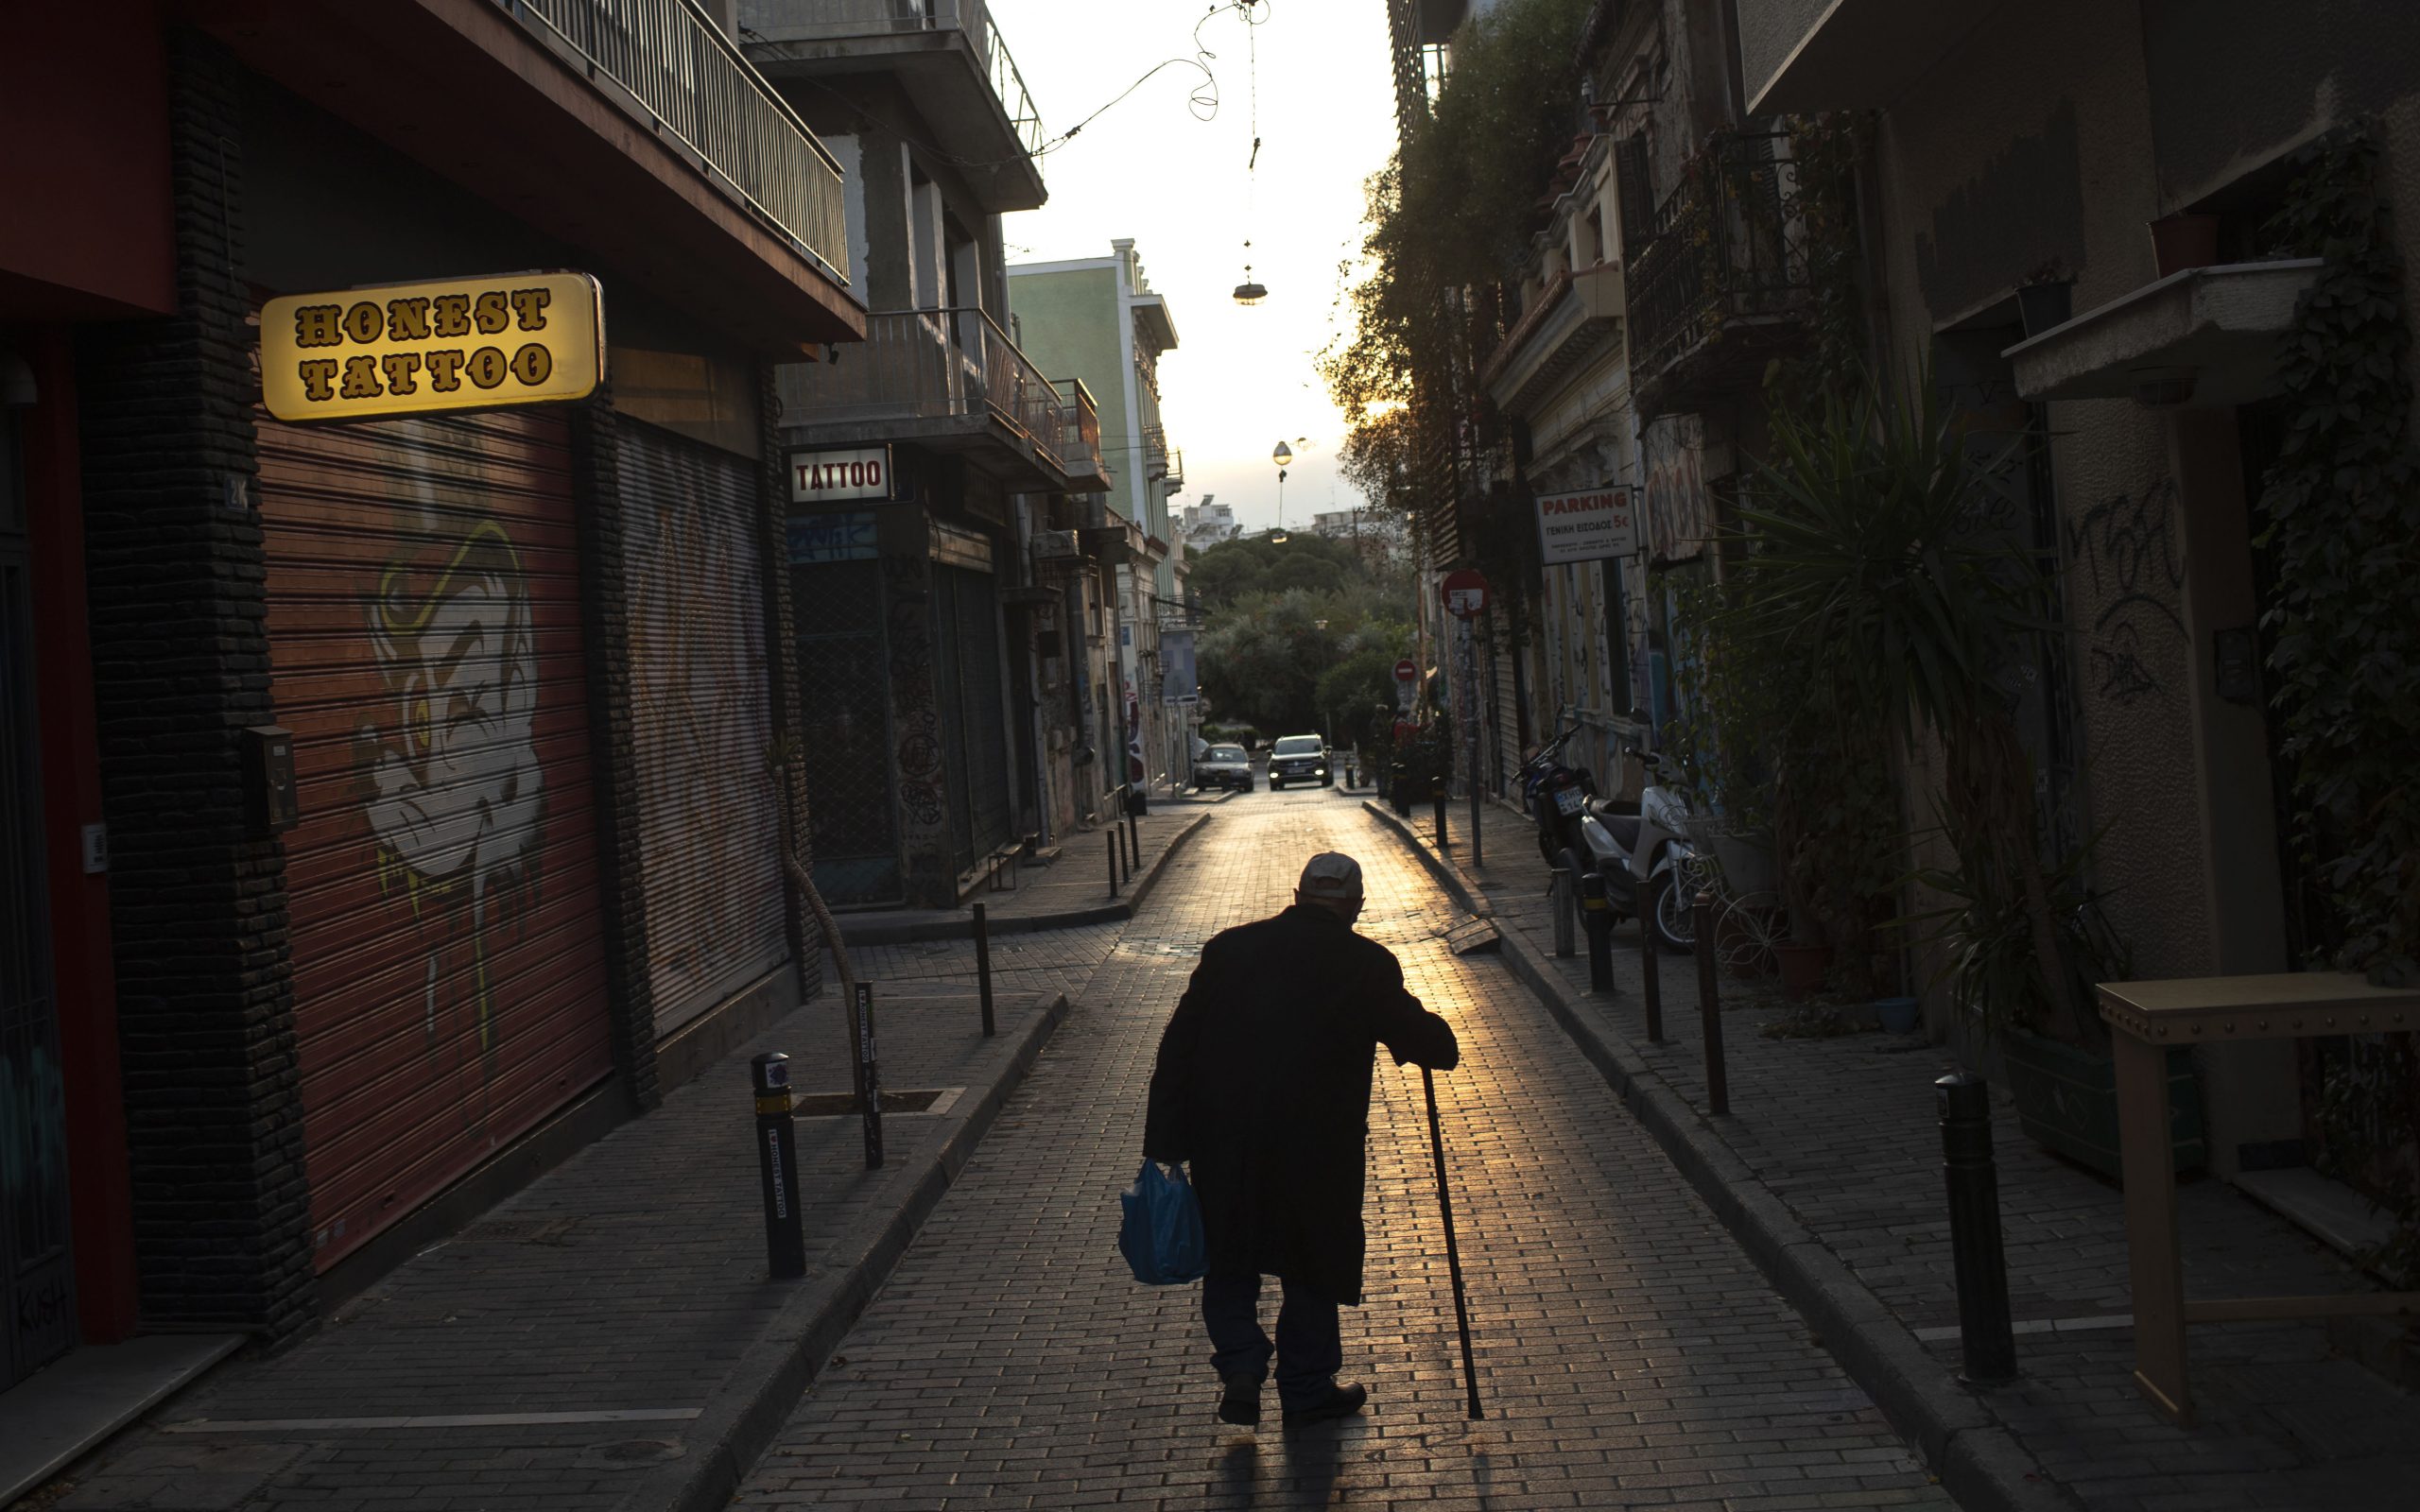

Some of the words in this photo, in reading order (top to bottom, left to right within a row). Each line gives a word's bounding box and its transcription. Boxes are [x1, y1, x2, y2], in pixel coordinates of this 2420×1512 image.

[295, 288, 550, 348] HONEST
[299, 343, 552, 402] TATTOO
[796, 460, 880, 490] TATTOO
[1543, 492, 1627, 515] PARKING
[1546, 524, 1574, 537] ΓΕΝΙΚΗ
[1577, 520, 1612, 533] ΕΙΣΟΔΟΣ
[770, 1144, 780, 1179] HONEST
[774, 1182, 785, 1216] TATTOO
